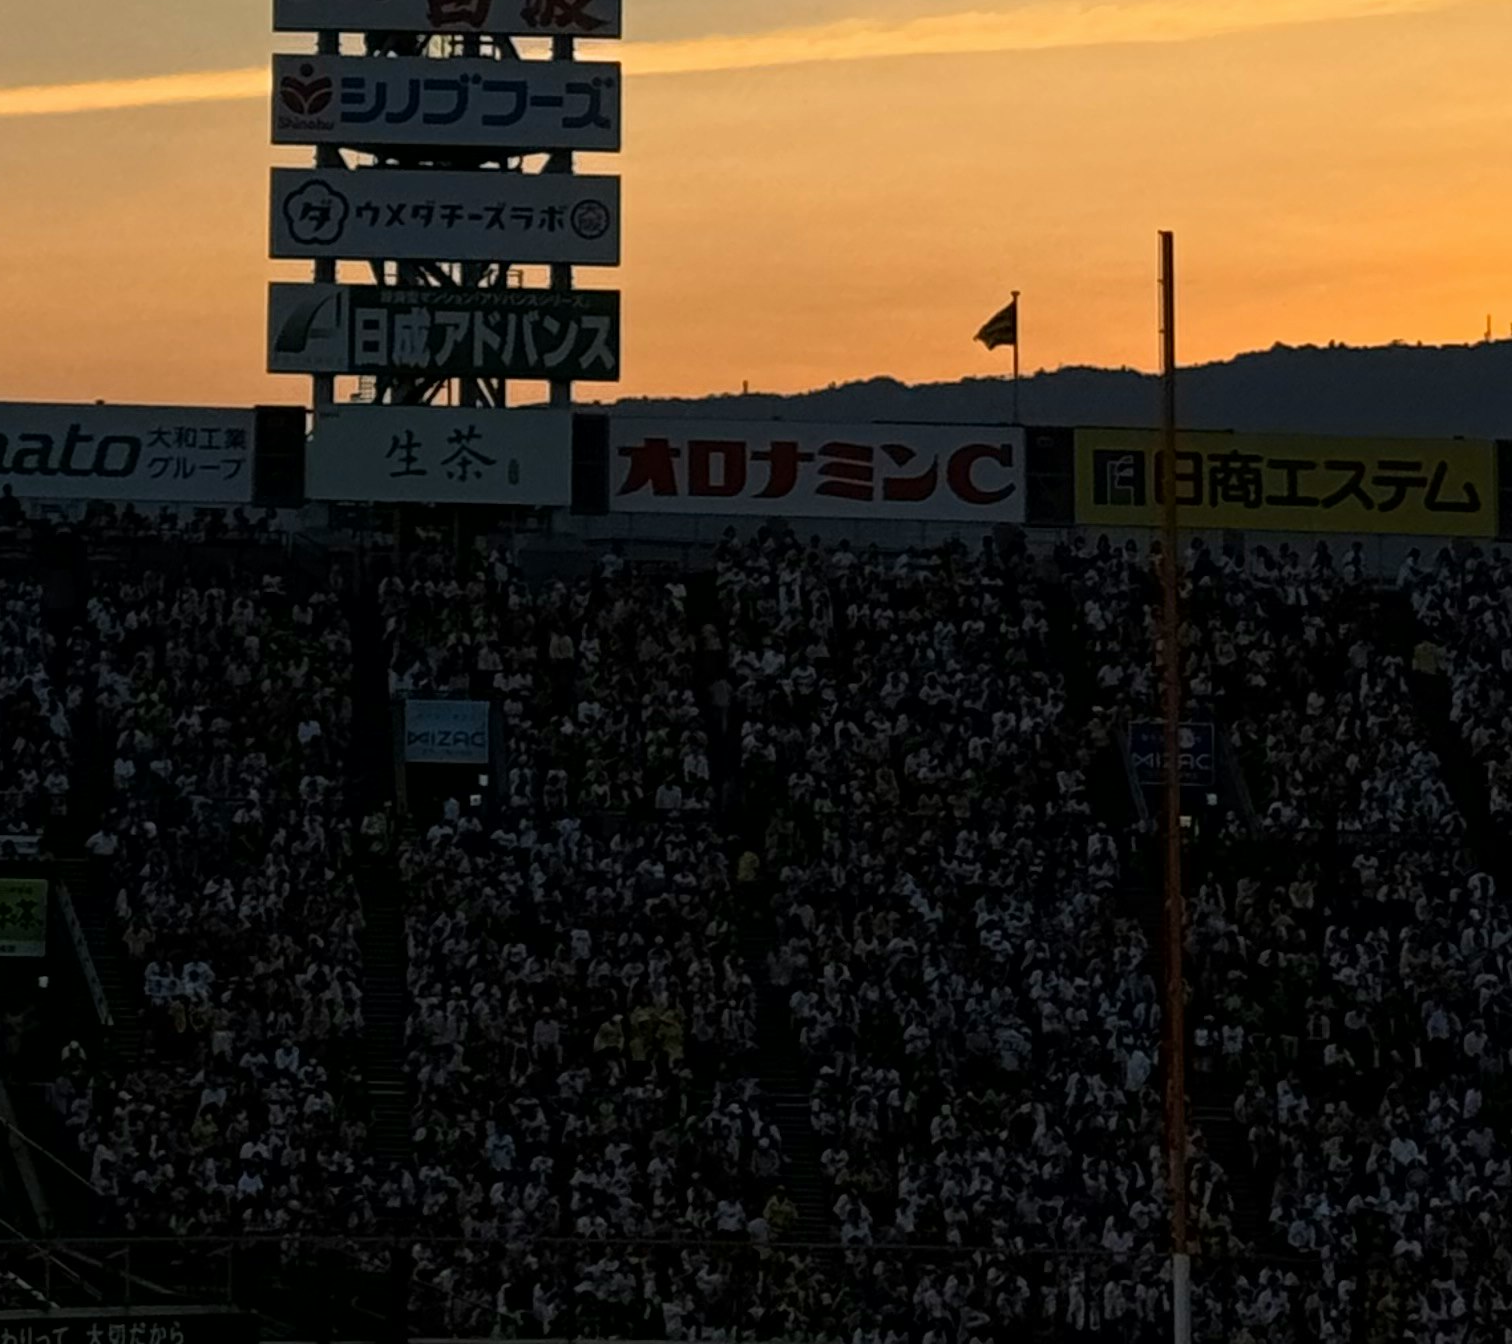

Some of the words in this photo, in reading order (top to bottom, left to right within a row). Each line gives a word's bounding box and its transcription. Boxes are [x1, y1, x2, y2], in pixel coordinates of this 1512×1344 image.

[341, 73, 615, 129] シノブフーズ
[356, 201, 569, 232] ウメダチーズラボ
[354, 306, 616, 369] 日成アドバンス
[147, 426, 247, 451] 大和工業
[385, 424, 497, 482] 生茶
[147, 455, 246, 481] グループ
[616, 438, 1016, 504] オロナミンC
[1154, 449, 1481, 513] 日商エステム
